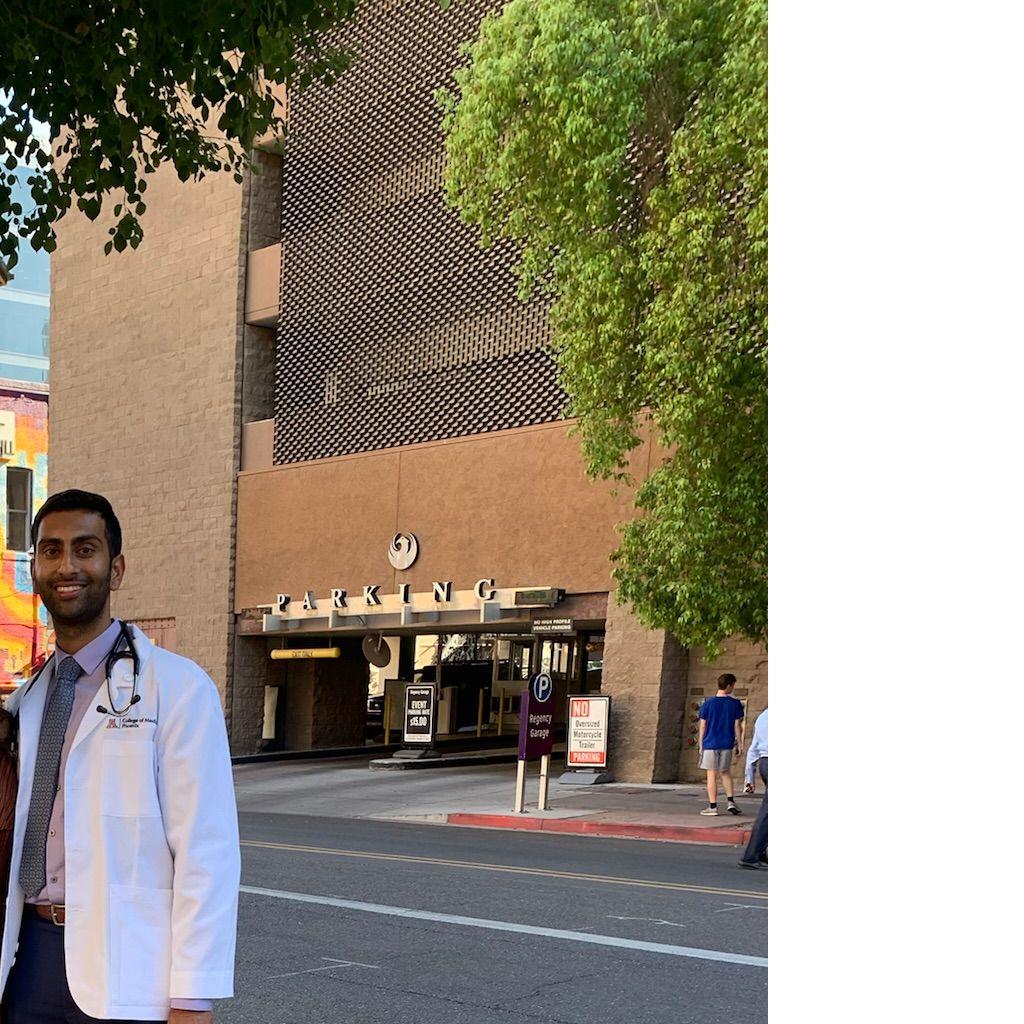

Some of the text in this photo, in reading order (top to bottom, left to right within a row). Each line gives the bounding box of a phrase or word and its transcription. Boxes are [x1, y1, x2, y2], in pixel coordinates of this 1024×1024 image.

[276, 578, 496, 612] PARKING
[411, 700, 427, 709] EVENT
[572, 700, 589, 717] NO
[529, 714, 552, 725] Regency
[575, 720, 600, 728] Oversized
[529, 728, 550, 740] Garage
[573, 730, 602, 739] Motorcycle
[579, 741, 596, 749] Trailer
[573, 752, 601, 763] PARKING
